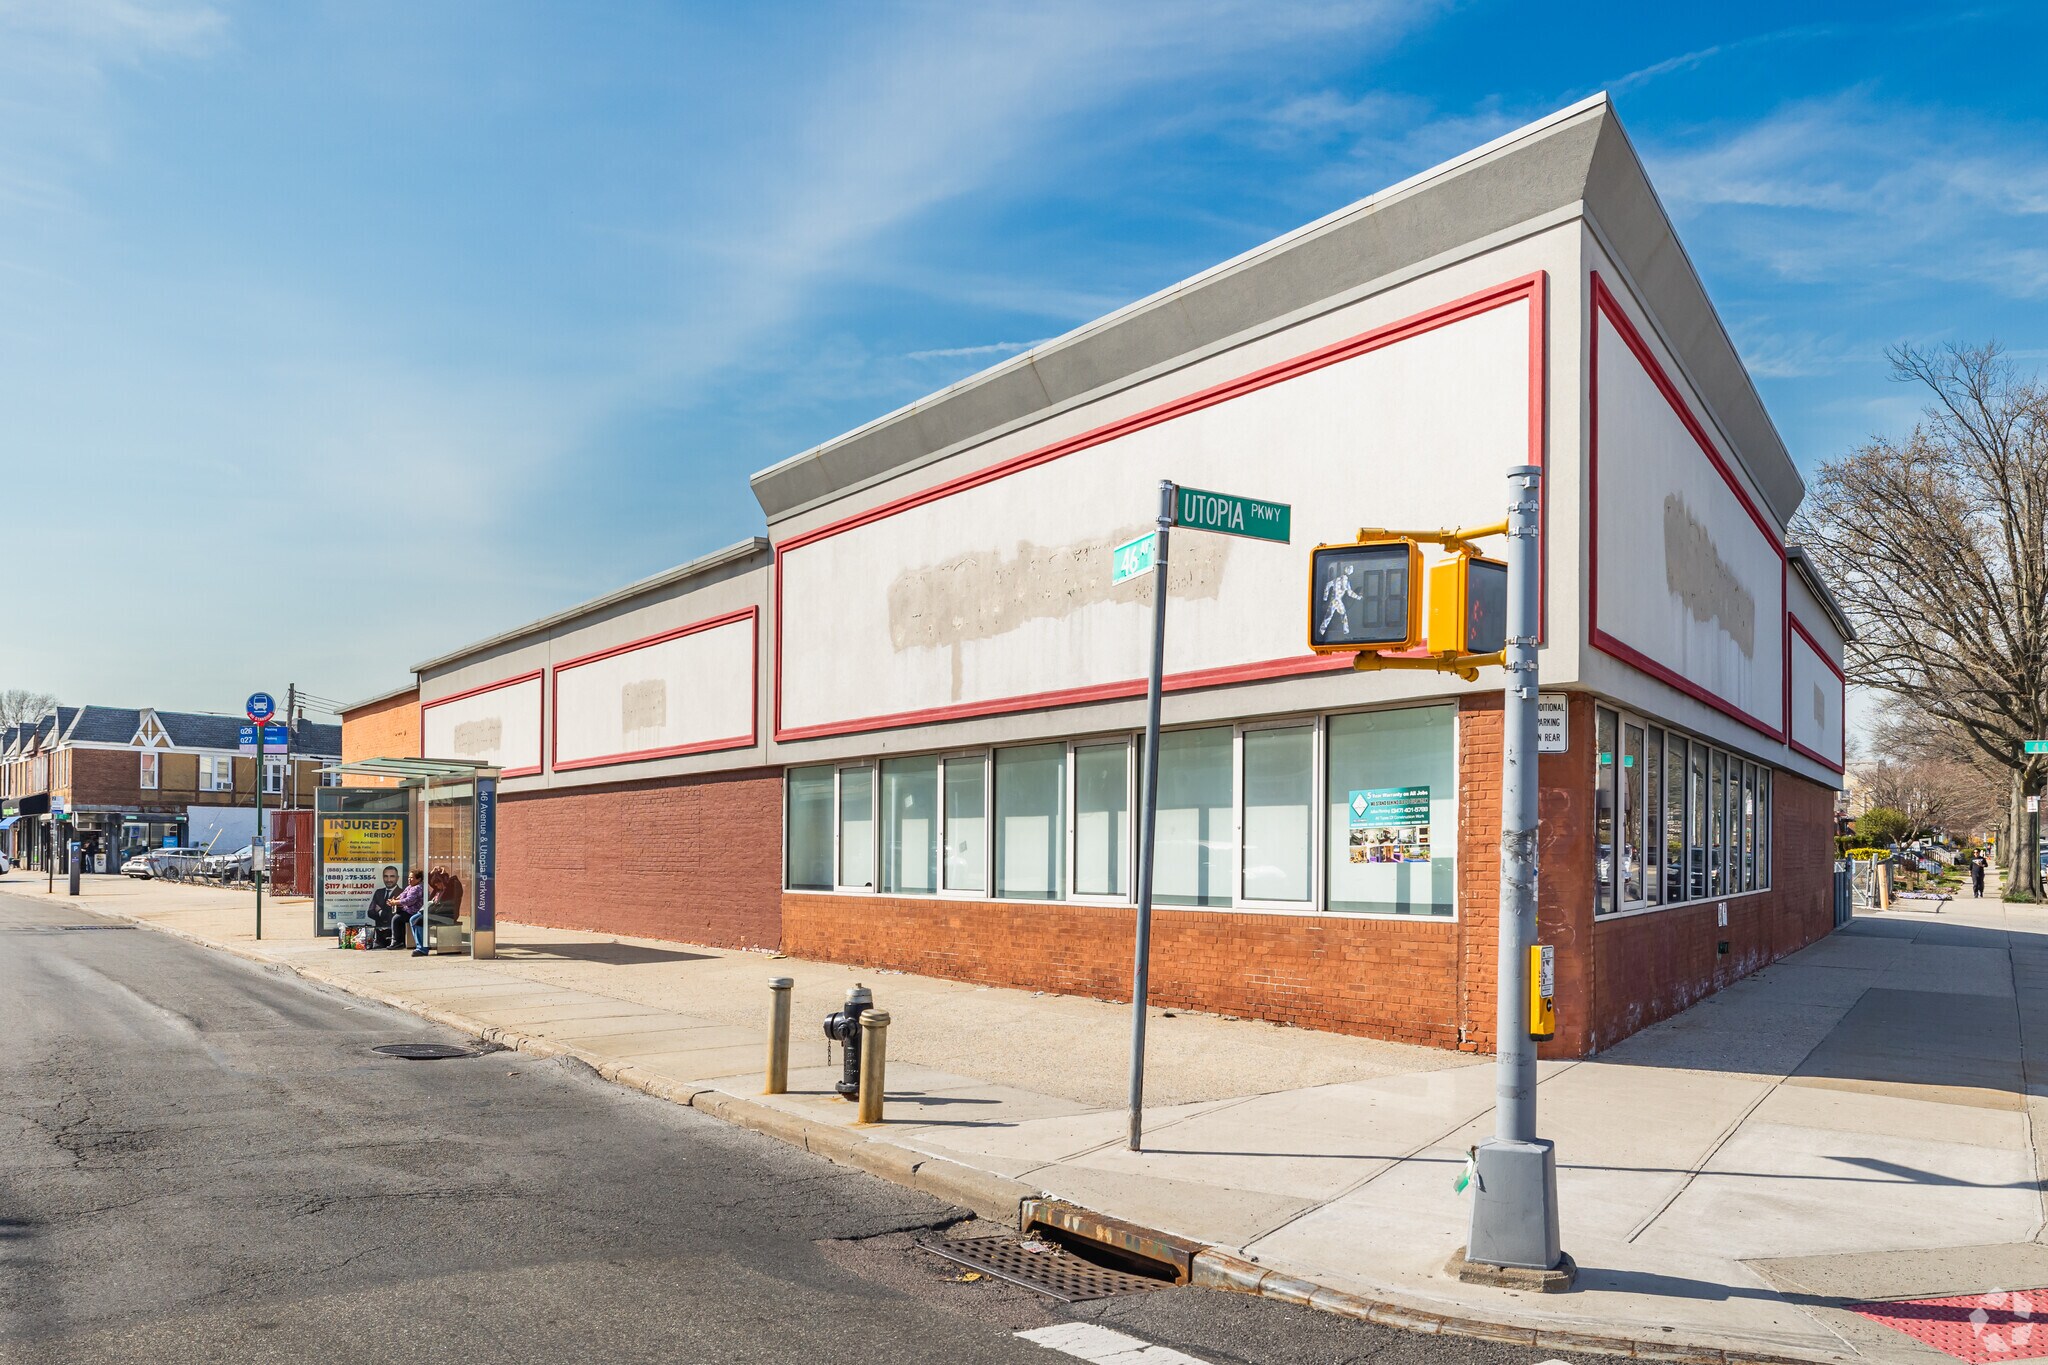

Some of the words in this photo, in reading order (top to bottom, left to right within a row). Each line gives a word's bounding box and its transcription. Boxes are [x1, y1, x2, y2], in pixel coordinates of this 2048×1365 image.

[1184, 493, 1244, 530] UTOPIA
[1251, 503, 1281, 522] PKWY
[1121, 546, 1138, 576] 46
[1538, 703, 1565, 711] DITIONAL
[480, 790, 488, 801] 46
[329, 820, 397, 830] INJURED?
[480, 803, 488, 835] Avenue
[478, 845, 488, 873] Utopia
[478, 875, 488, 911] Parkway
